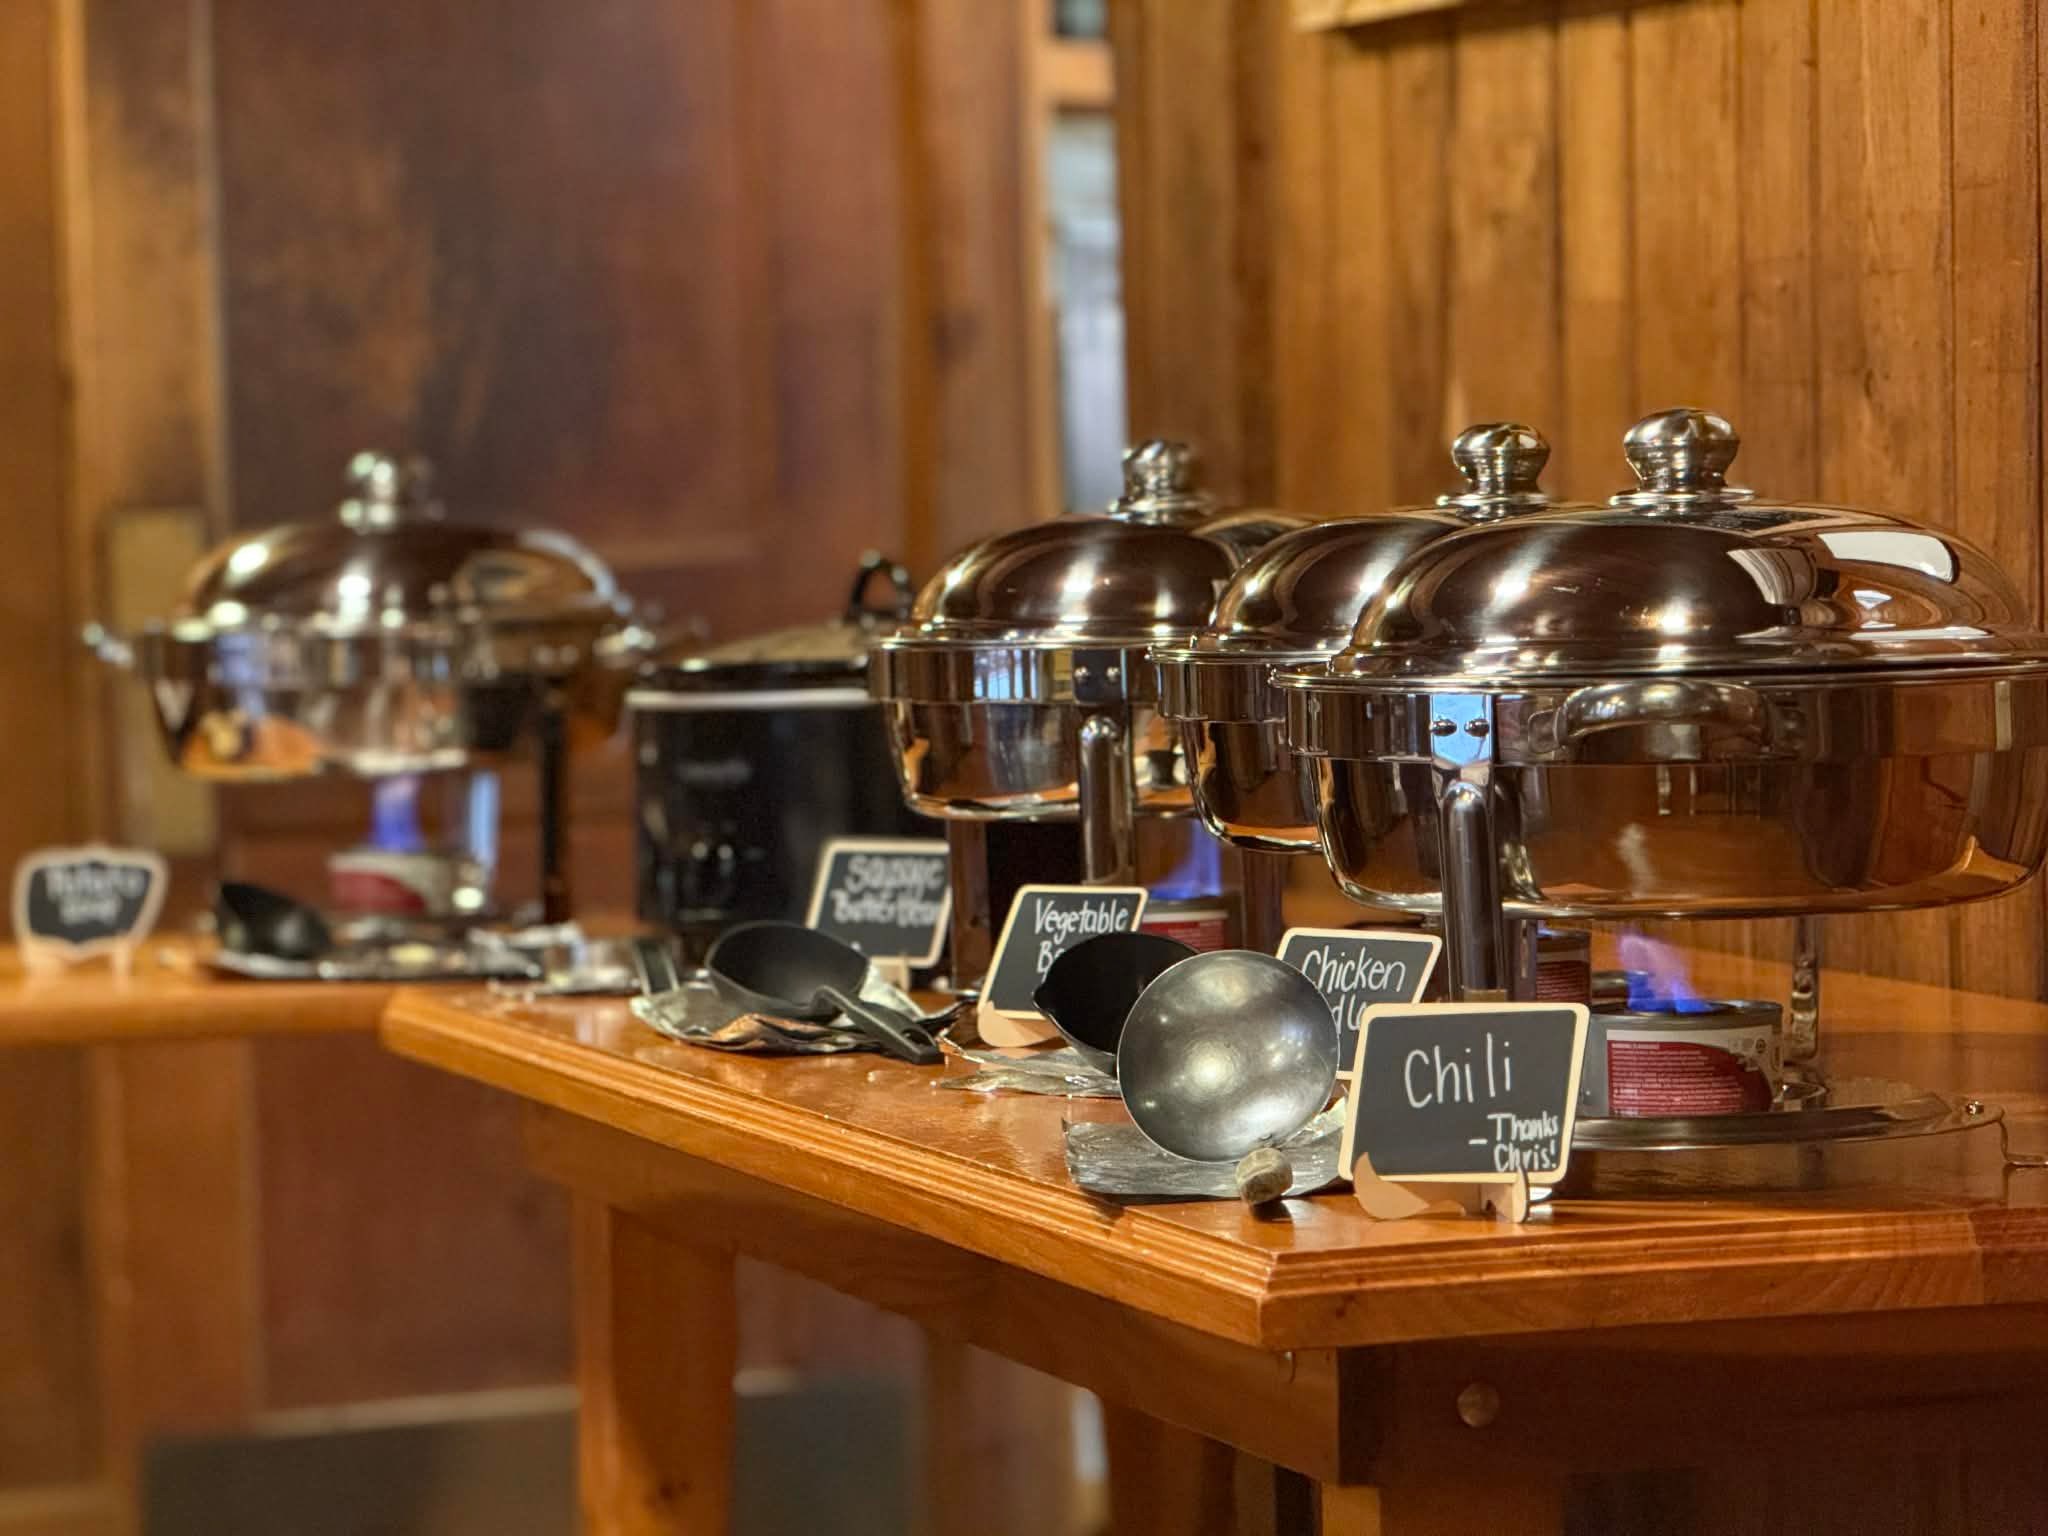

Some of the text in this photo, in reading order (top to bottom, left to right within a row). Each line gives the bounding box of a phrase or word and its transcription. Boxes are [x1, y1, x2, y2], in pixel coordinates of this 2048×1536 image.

[1034, 898, 1129, 944] Vegetable
[1302, 945, 1406, 994] Chicken
[1404, 1032, 1511, 1108] Chili
[1494, 1139, 1557, 1172] Chris!
